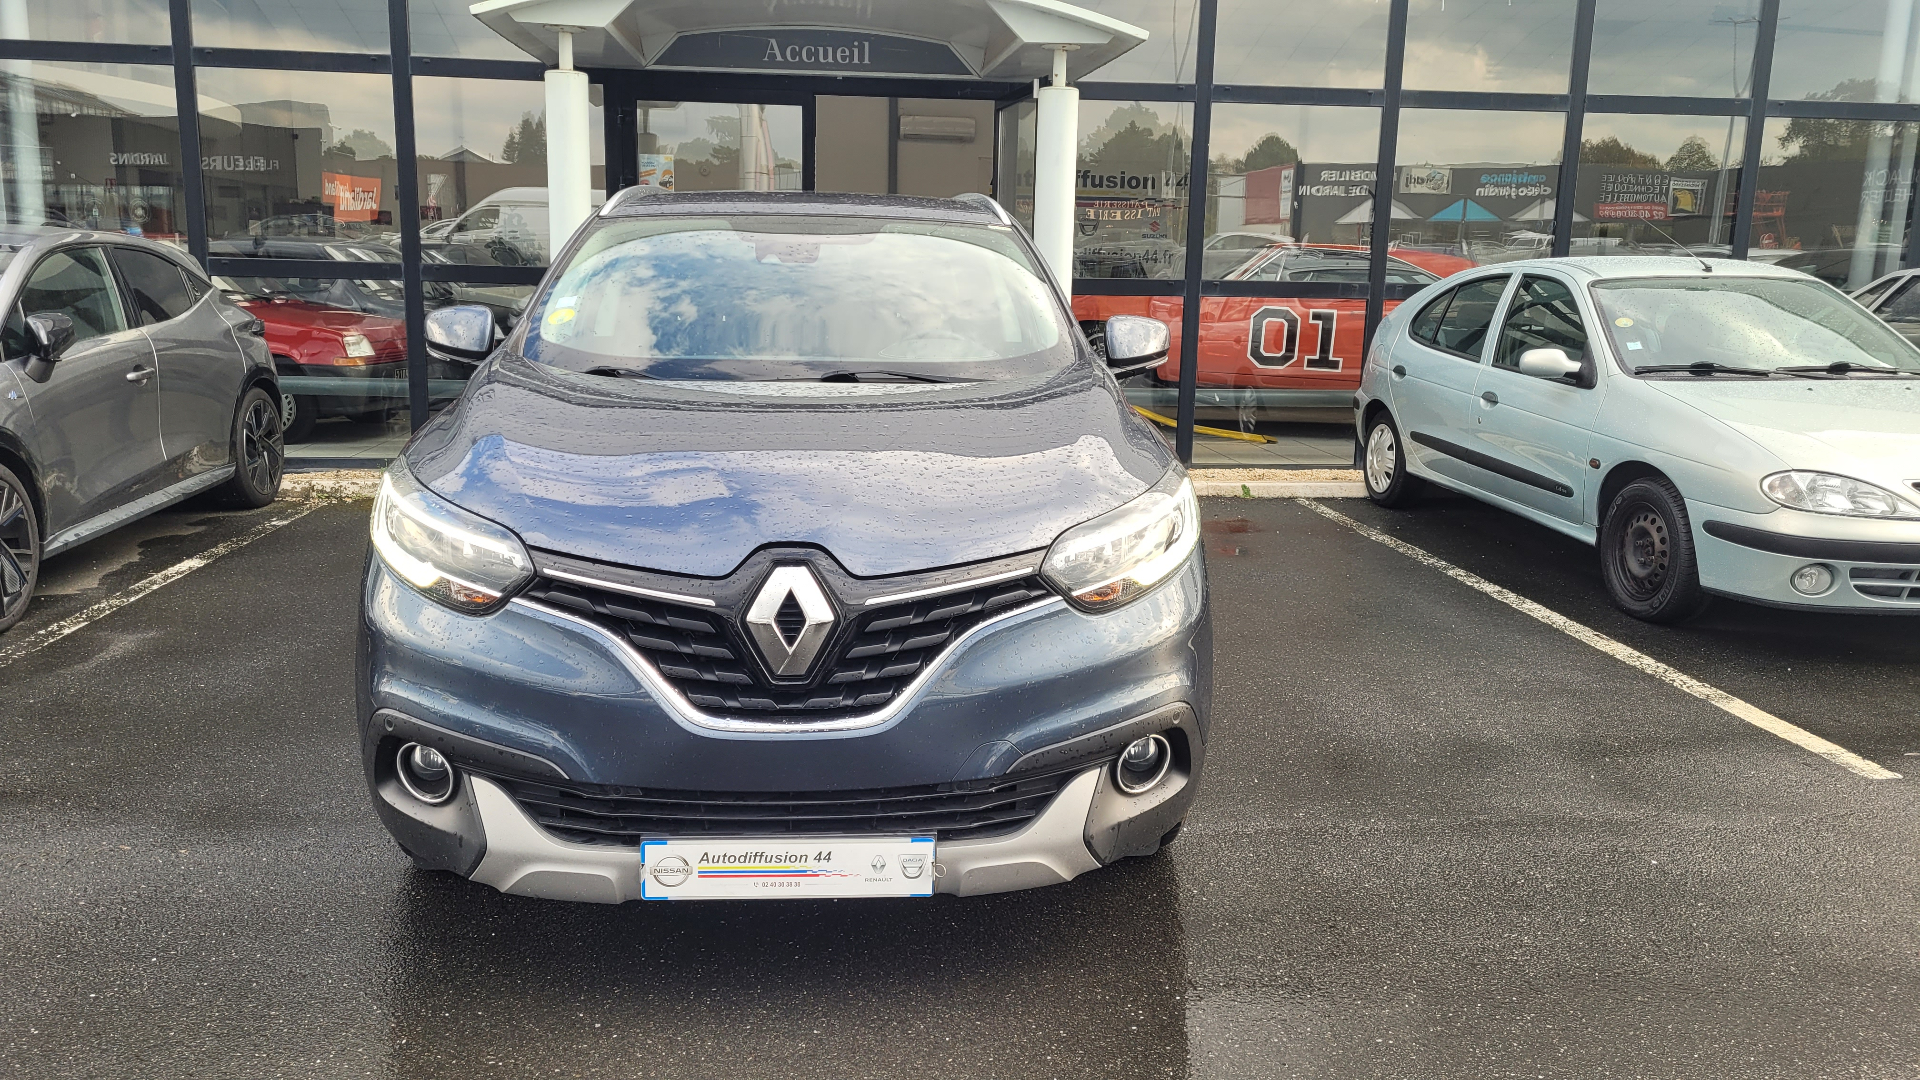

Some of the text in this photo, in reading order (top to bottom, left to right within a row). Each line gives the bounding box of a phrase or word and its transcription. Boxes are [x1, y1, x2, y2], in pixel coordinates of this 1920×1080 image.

[762, 38, 871, 64] Accueil
[1076, 169, 1156, 190] ffusion
[1247, 305, 1344, 373] 01
[698, 850, 833, 865] Autodiffusion 44
